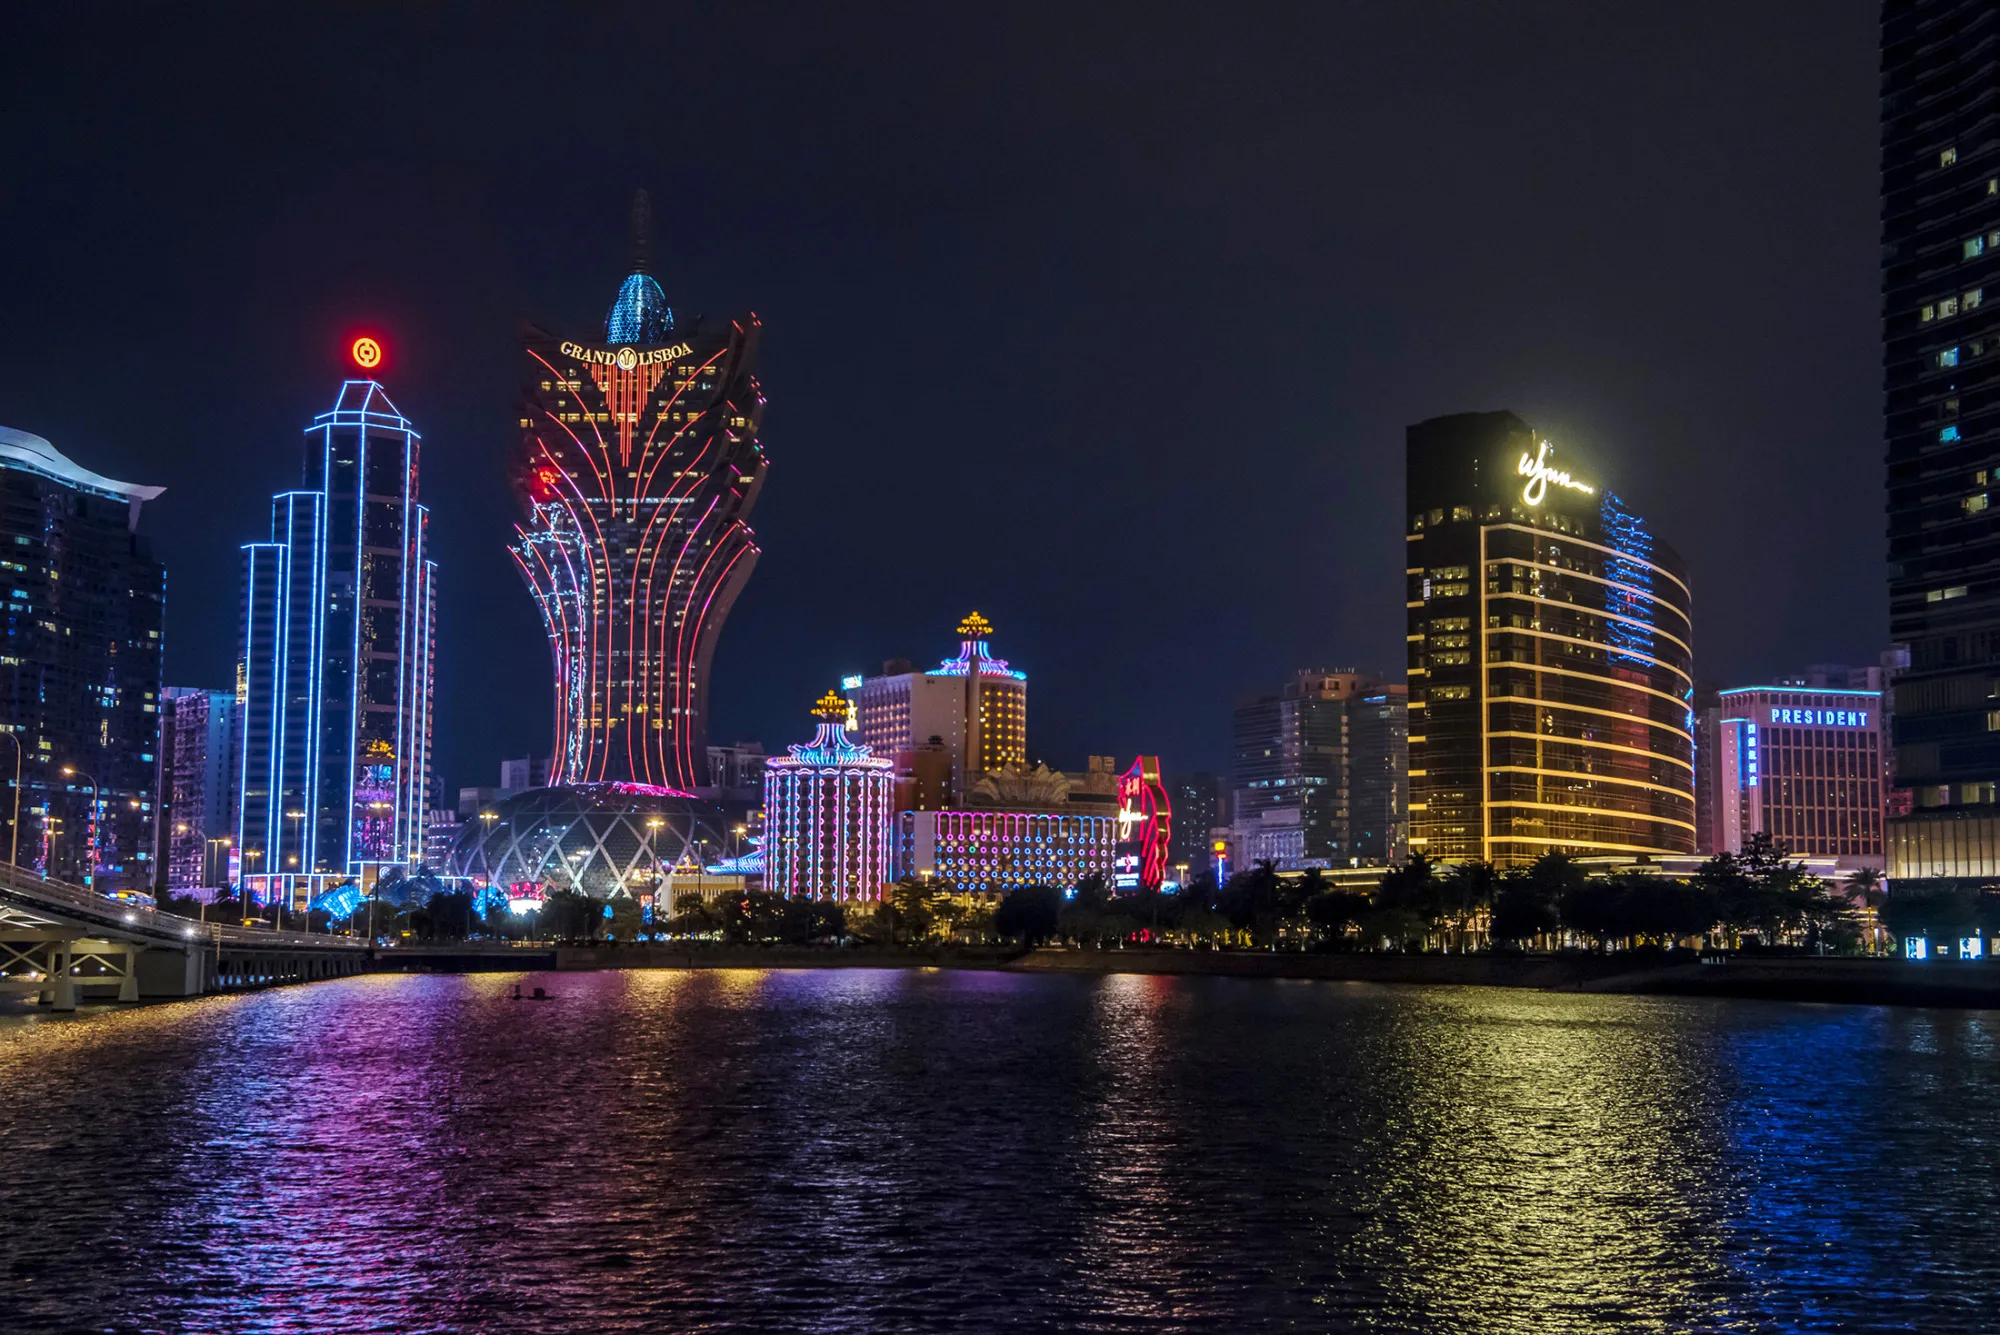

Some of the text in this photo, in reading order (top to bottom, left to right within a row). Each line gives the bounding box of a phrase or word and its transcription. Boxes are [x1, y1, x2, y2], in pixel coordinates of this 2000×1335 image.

[560, 341, 693, 366] GRAND LISBOA
[1771, 708, 1868, 727] PRESIDENT
